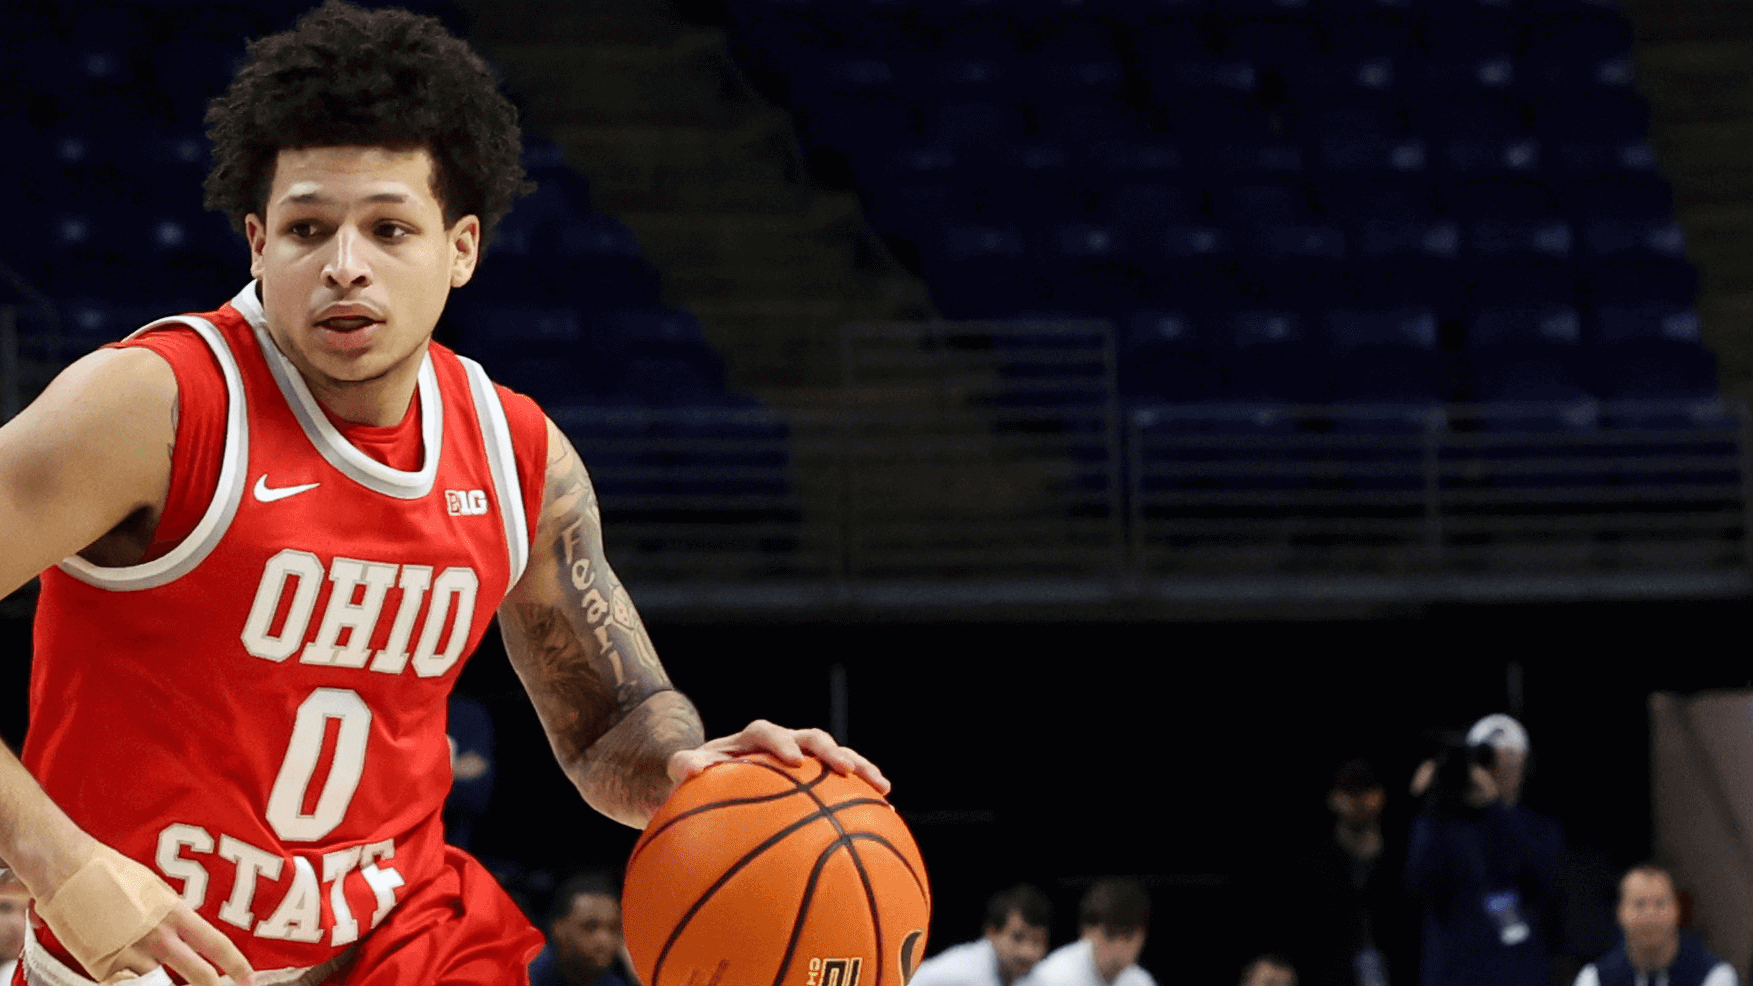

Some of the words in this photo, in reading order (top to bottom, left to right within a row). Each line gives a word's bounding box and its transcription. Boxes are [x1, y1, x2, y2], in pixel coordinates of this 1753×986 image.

[240, 548, 479, 678] OHIO
[265, 687, 372, 842] 0
[155, 822, 405, 947] STATE
